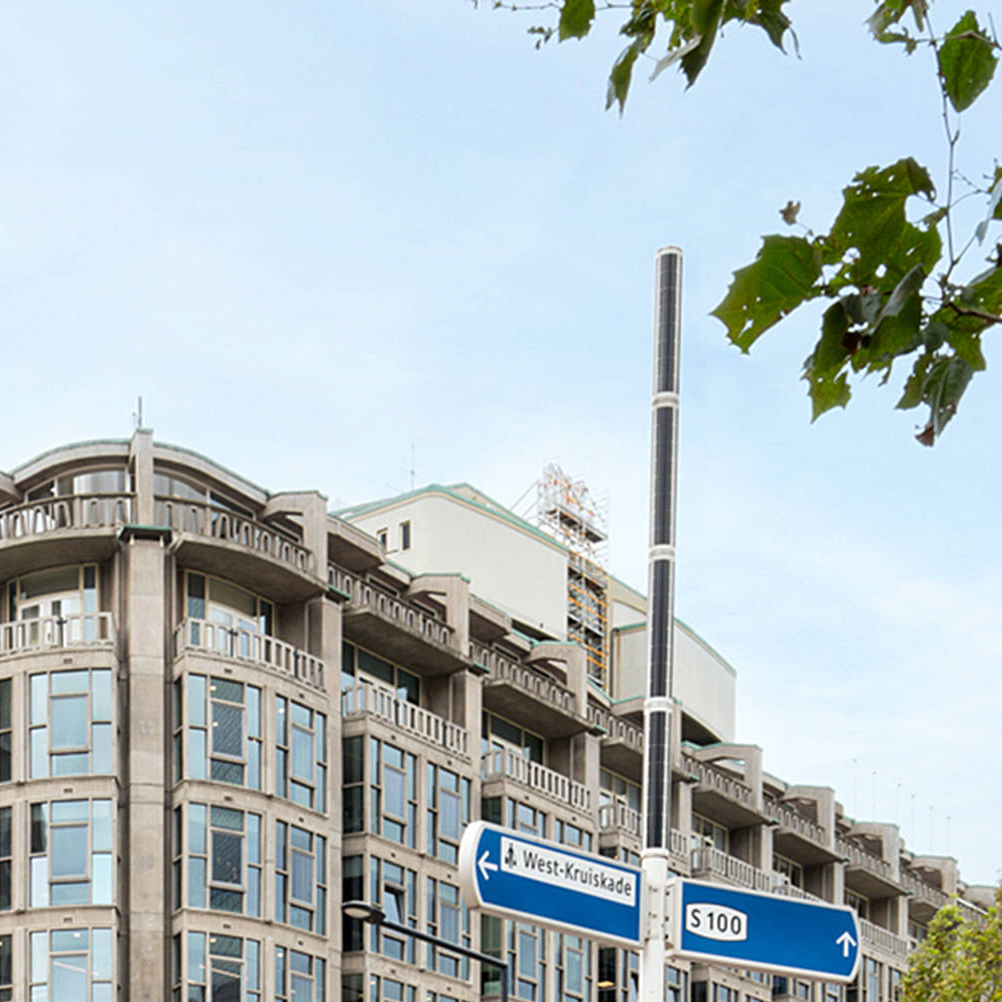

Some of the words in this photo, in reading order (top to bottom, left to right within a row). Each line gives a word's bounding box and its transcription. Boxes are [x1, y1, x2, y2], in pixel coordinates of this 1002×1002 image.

[523, 850, 632, 896] West-Kruiskade
[691, 909, 701, 928] S
[707, 911, 741, 935] 100
